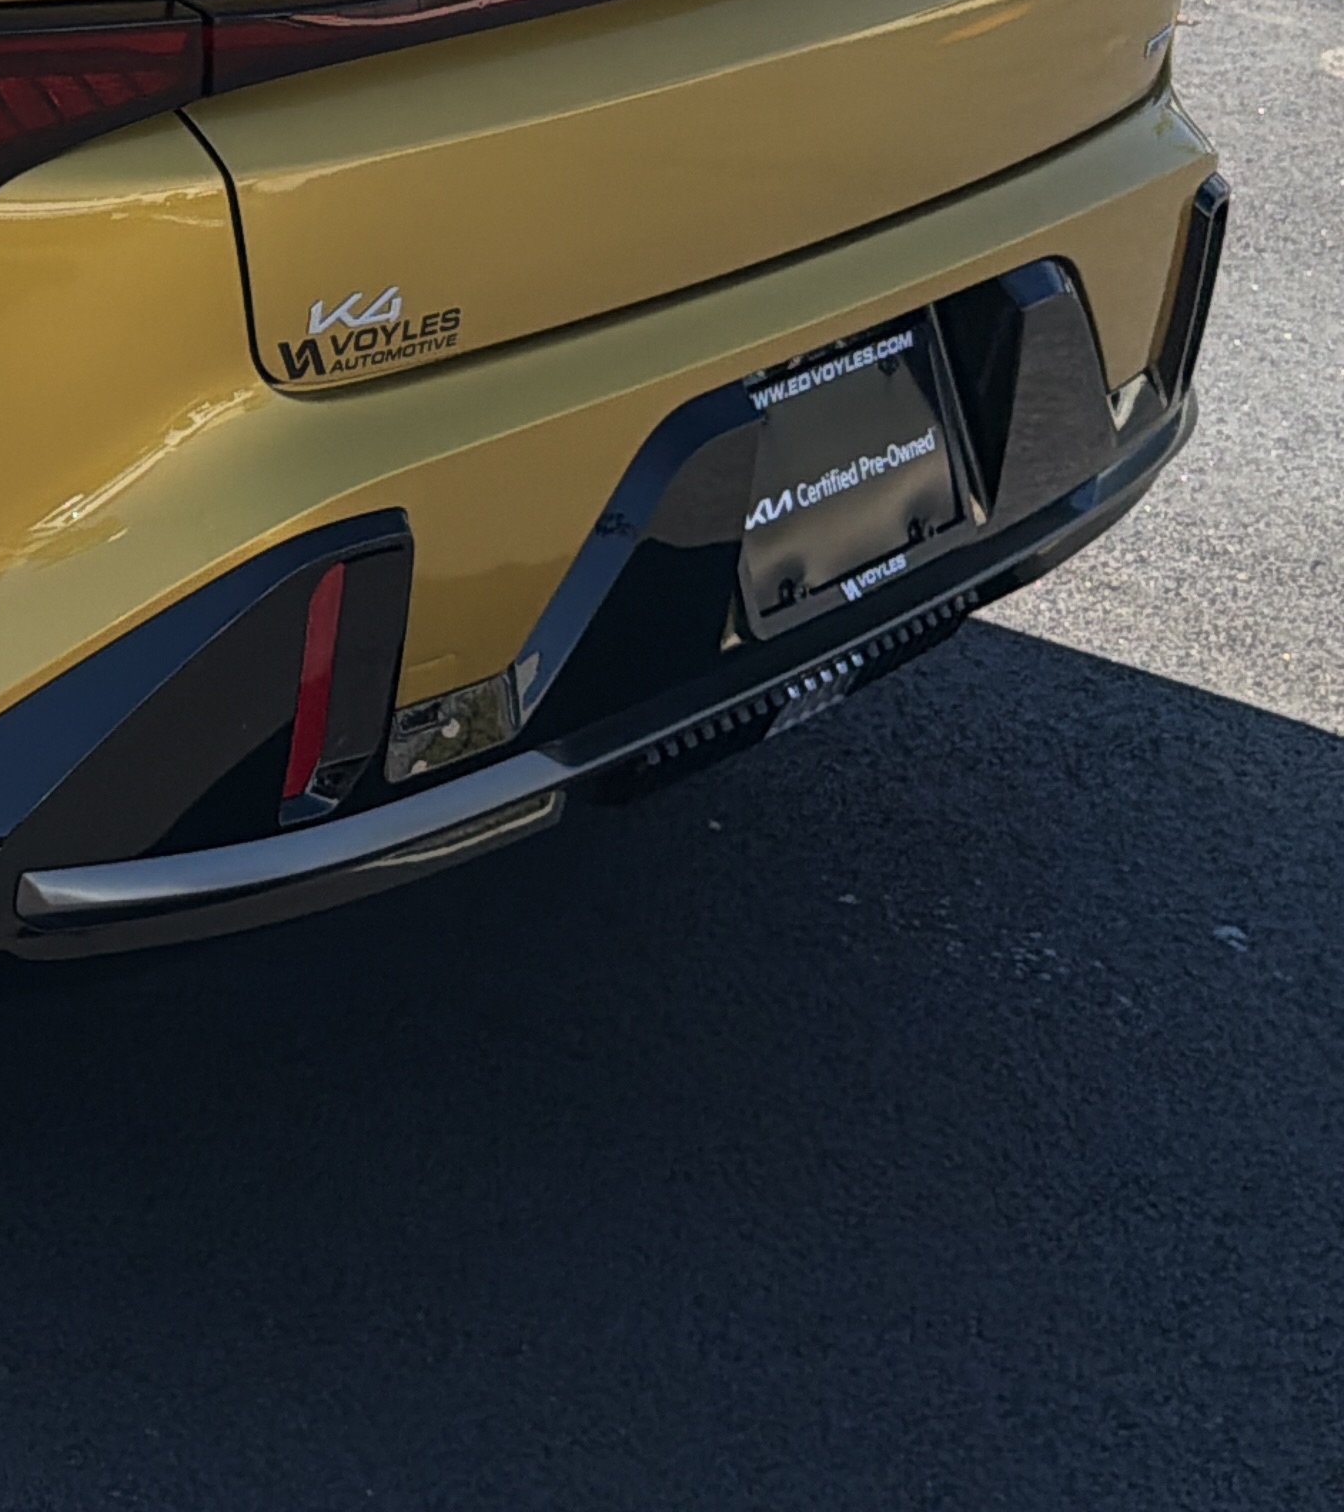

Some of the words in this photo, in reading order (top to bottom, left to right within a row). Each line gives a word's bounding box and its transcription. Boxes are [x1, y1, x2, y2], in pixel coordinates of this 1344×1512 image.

[308, 285, 402, 335] K4
[329, 307, 461, 357] VOYLES
[329, 332, 459, 374] AUTOMOTIVE
[748, 330, 913, 410] WW.EDVOYLES.COM
[744, 489, 794, 531] KIA
[796, 461, 859, 508] Certified
[859, 428, 936, 481] Pre-Owned
[859, 553, 907, 589] VOYLES
